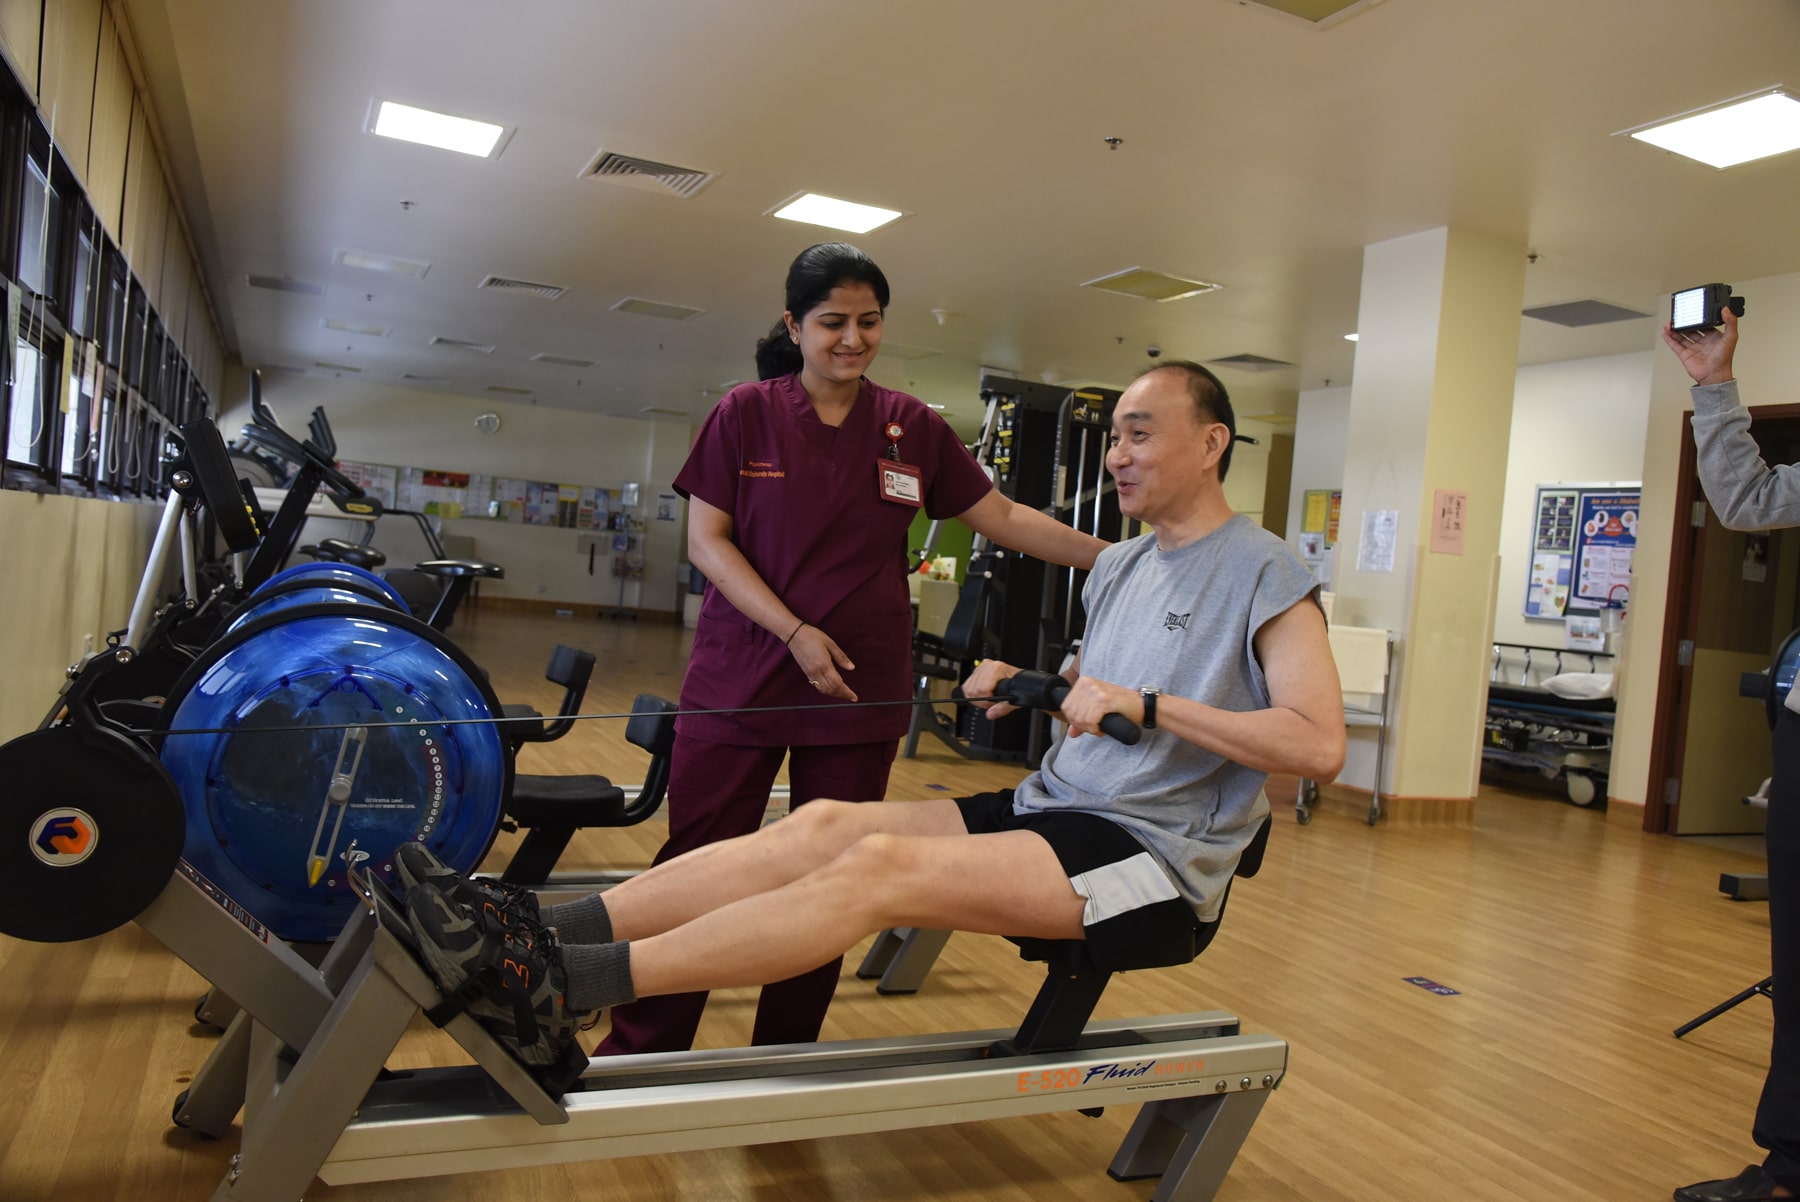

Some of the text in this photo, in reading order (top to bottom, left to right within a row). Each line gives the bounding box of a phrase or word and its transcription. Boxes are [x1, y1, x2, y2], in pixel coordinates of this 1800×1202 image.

[1162, 611, 1191, 628] EVERLAST
[1017, 1067, 1081, 1091] E-520
[1083, 1060, 1156, 1084] Fluid
